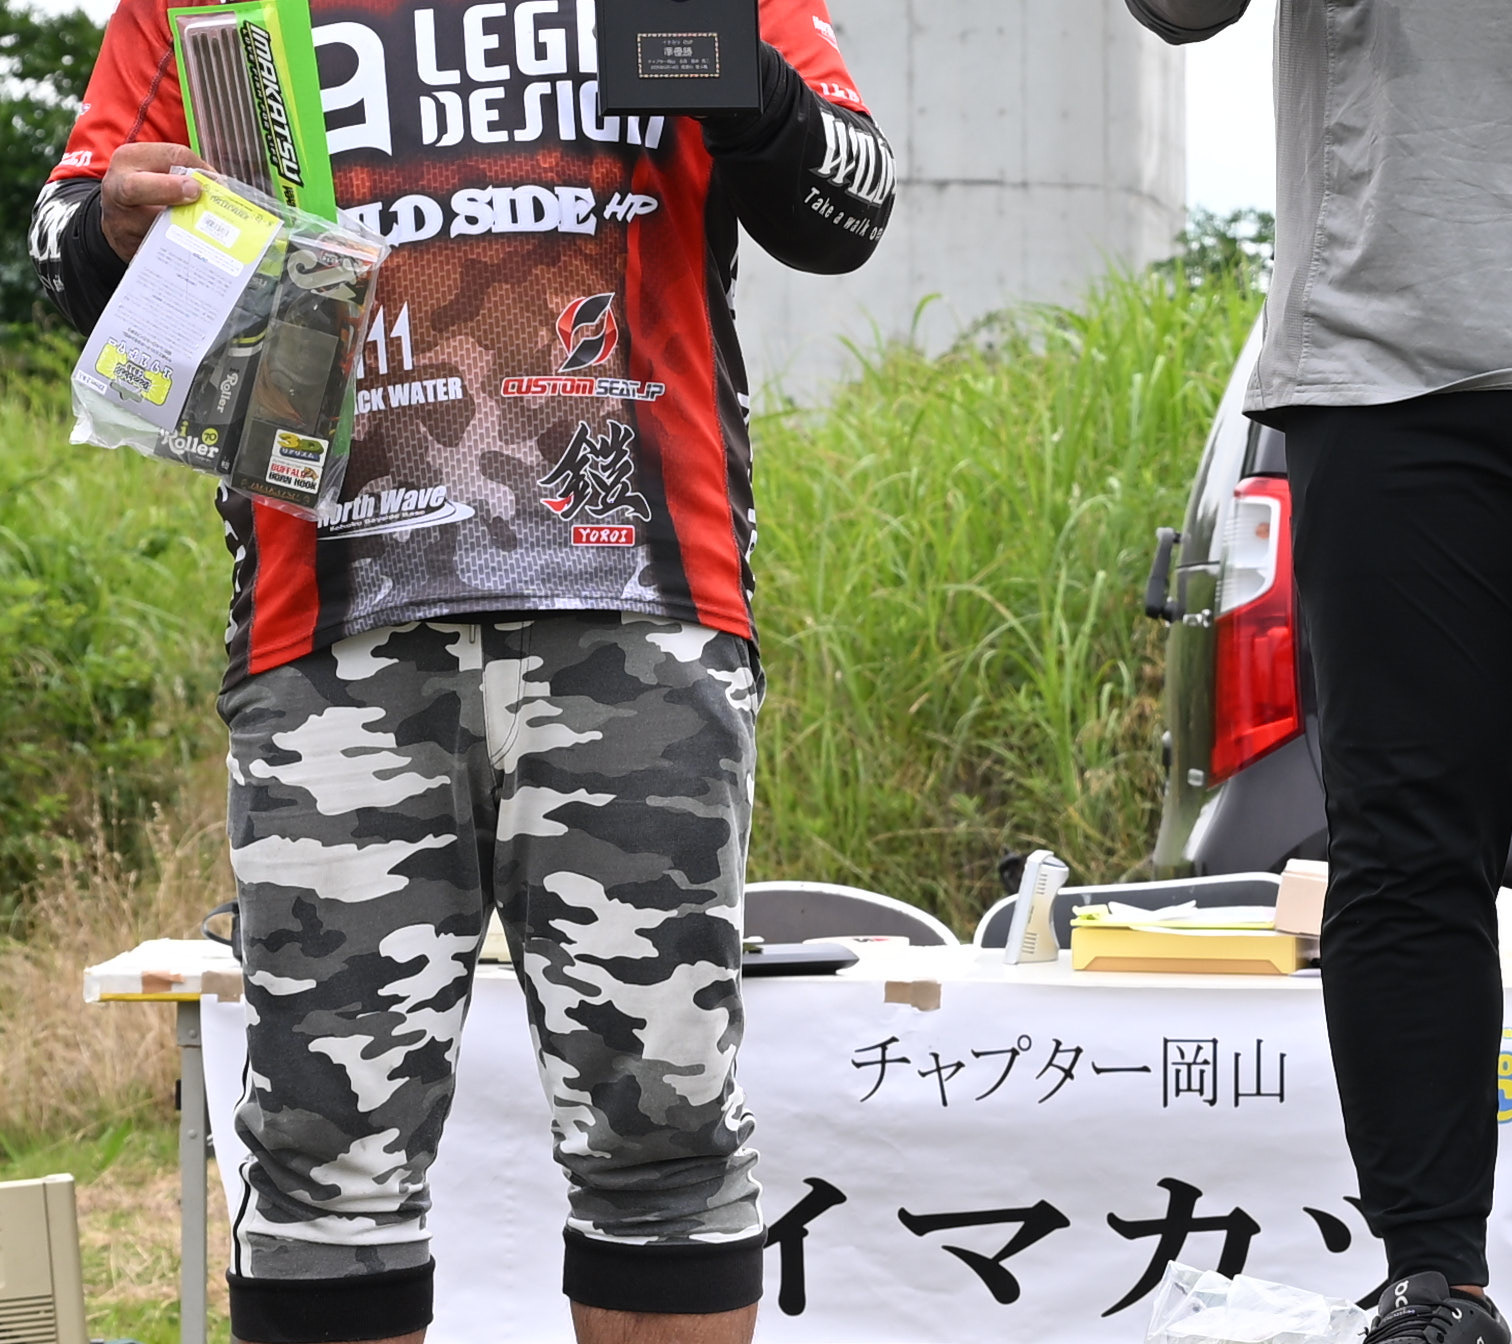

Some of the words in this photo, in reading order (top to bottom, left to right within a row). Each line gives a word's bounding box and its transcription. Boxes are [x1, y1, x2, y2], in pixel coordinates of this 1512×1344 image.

[414, 0, 597, 86] LEGI
[247, 23, 302, 187] IMAKATSU
[339, 194, 443, 248] LD
[450, 185, 597, 239] SIDE
[603, 192, 659, 223] HP
[804, 187, 833, 219] Take
[843, 214, 870, 239] walk
[389, 377, 463, 408] WATER
[203, 432, 218, 443] 70
[279, 432, 325, 455] 3D
[538, 419, 652, 522] 鎧
[381, 485, 448, 511] Wave
[579, 527, 628, 543] YOROI
[850, 1034, 1287, 1109] チャプター岡山
